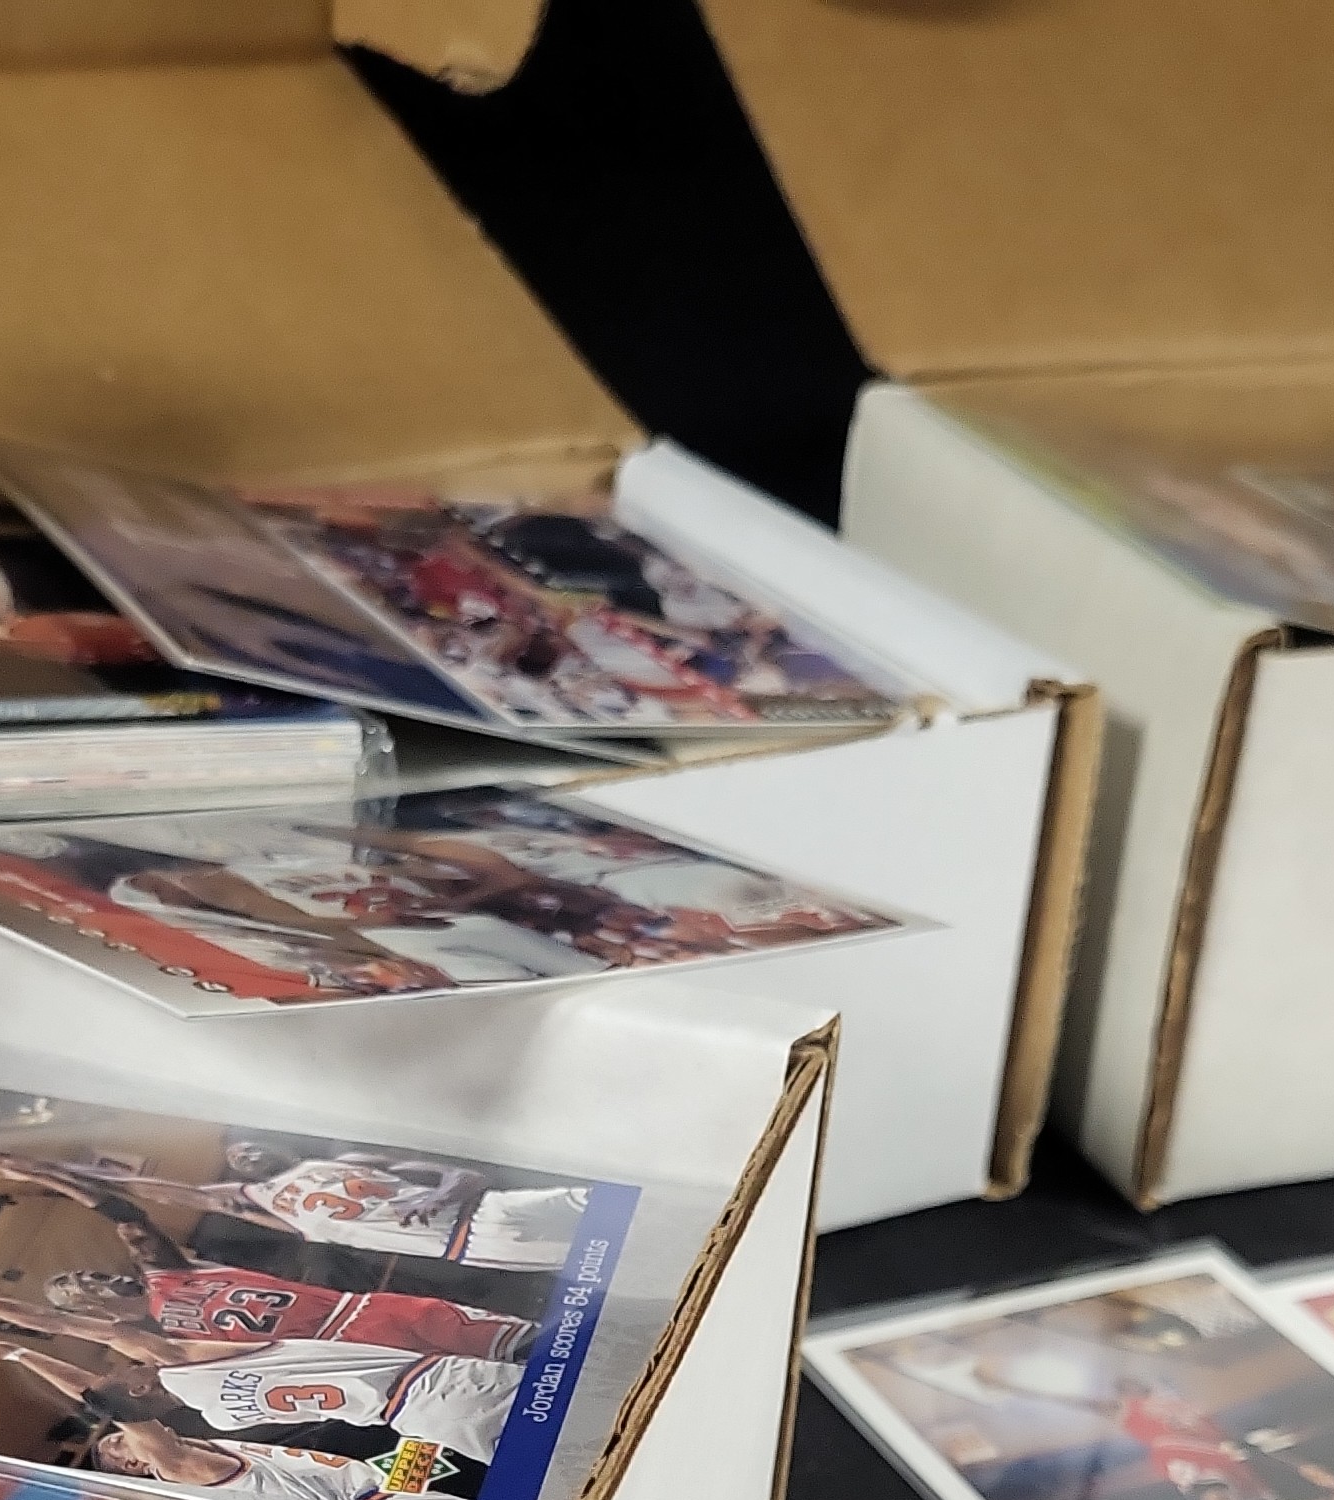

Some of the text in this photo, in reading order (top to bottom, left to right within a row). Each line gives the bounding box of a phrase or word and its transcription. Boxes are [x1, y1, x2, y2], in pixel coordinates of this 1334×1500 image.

[214, 1288, 299, 1336] 23
[522, 1238, 610, 1424] Jordan scores 54 points
[264, 1383, 347, 1413] 3
[388, 1441, 420, 1491] UPPER
[404, 1444, 439, 1494] DECK
